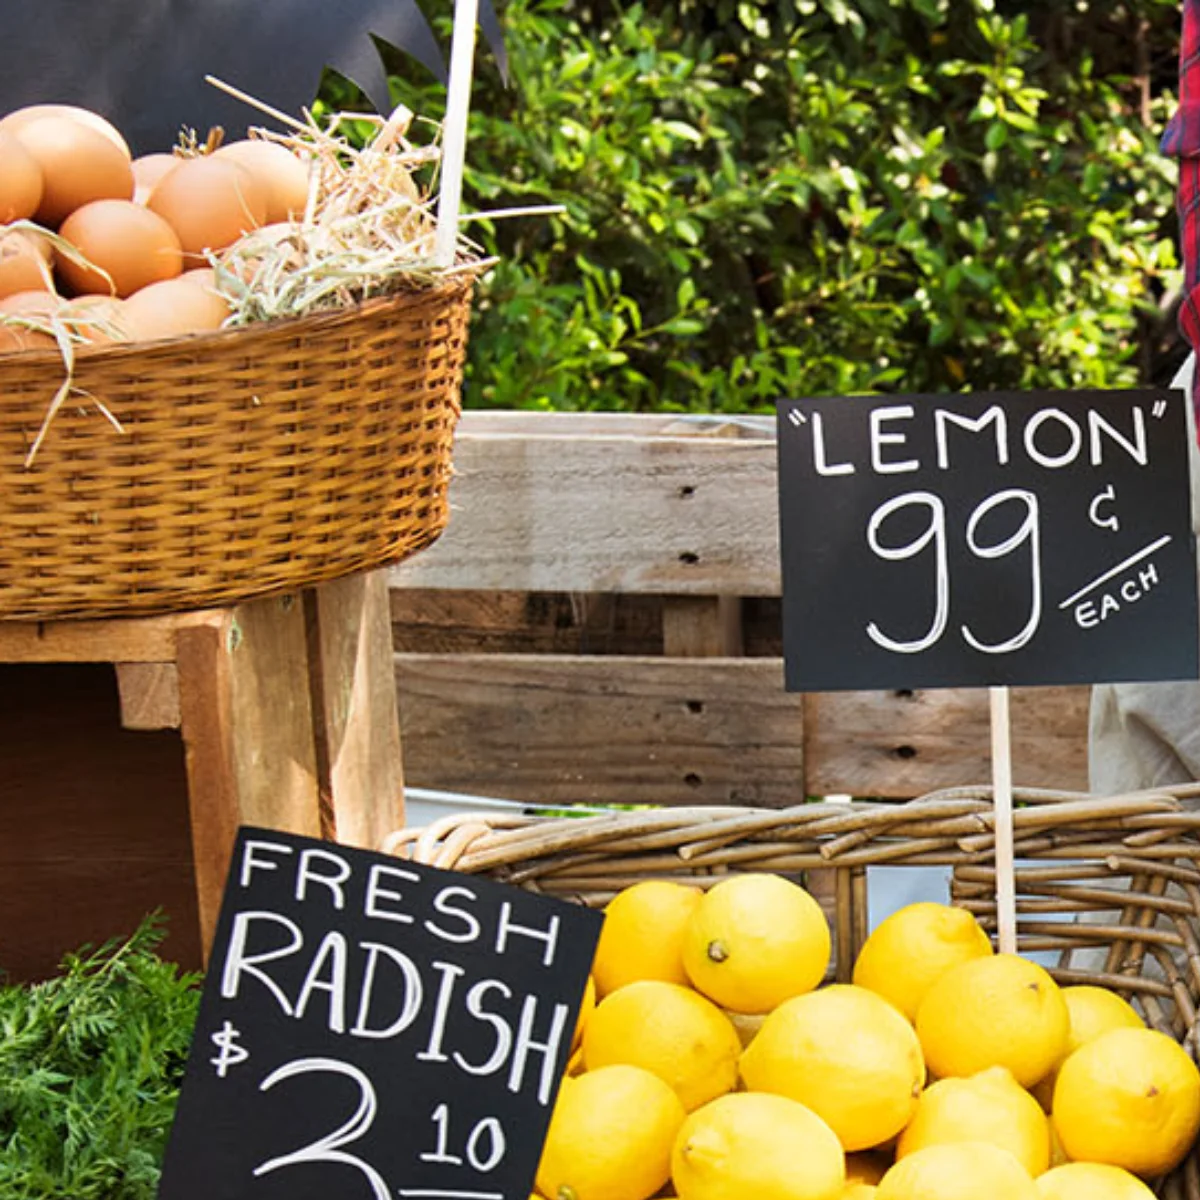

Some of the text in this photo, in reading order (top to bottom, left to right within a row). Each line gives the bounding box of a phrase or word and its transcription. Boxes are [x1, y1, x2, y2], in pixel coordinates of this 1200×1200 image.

[866, 488, 1041, 654] 99
[1073, 563, 1161, 629] EACH
[240, 840, 561, 967] FRESH
[220, 910, 569, 1105] RADISH
[420, 1103, 508, 1173] 10
